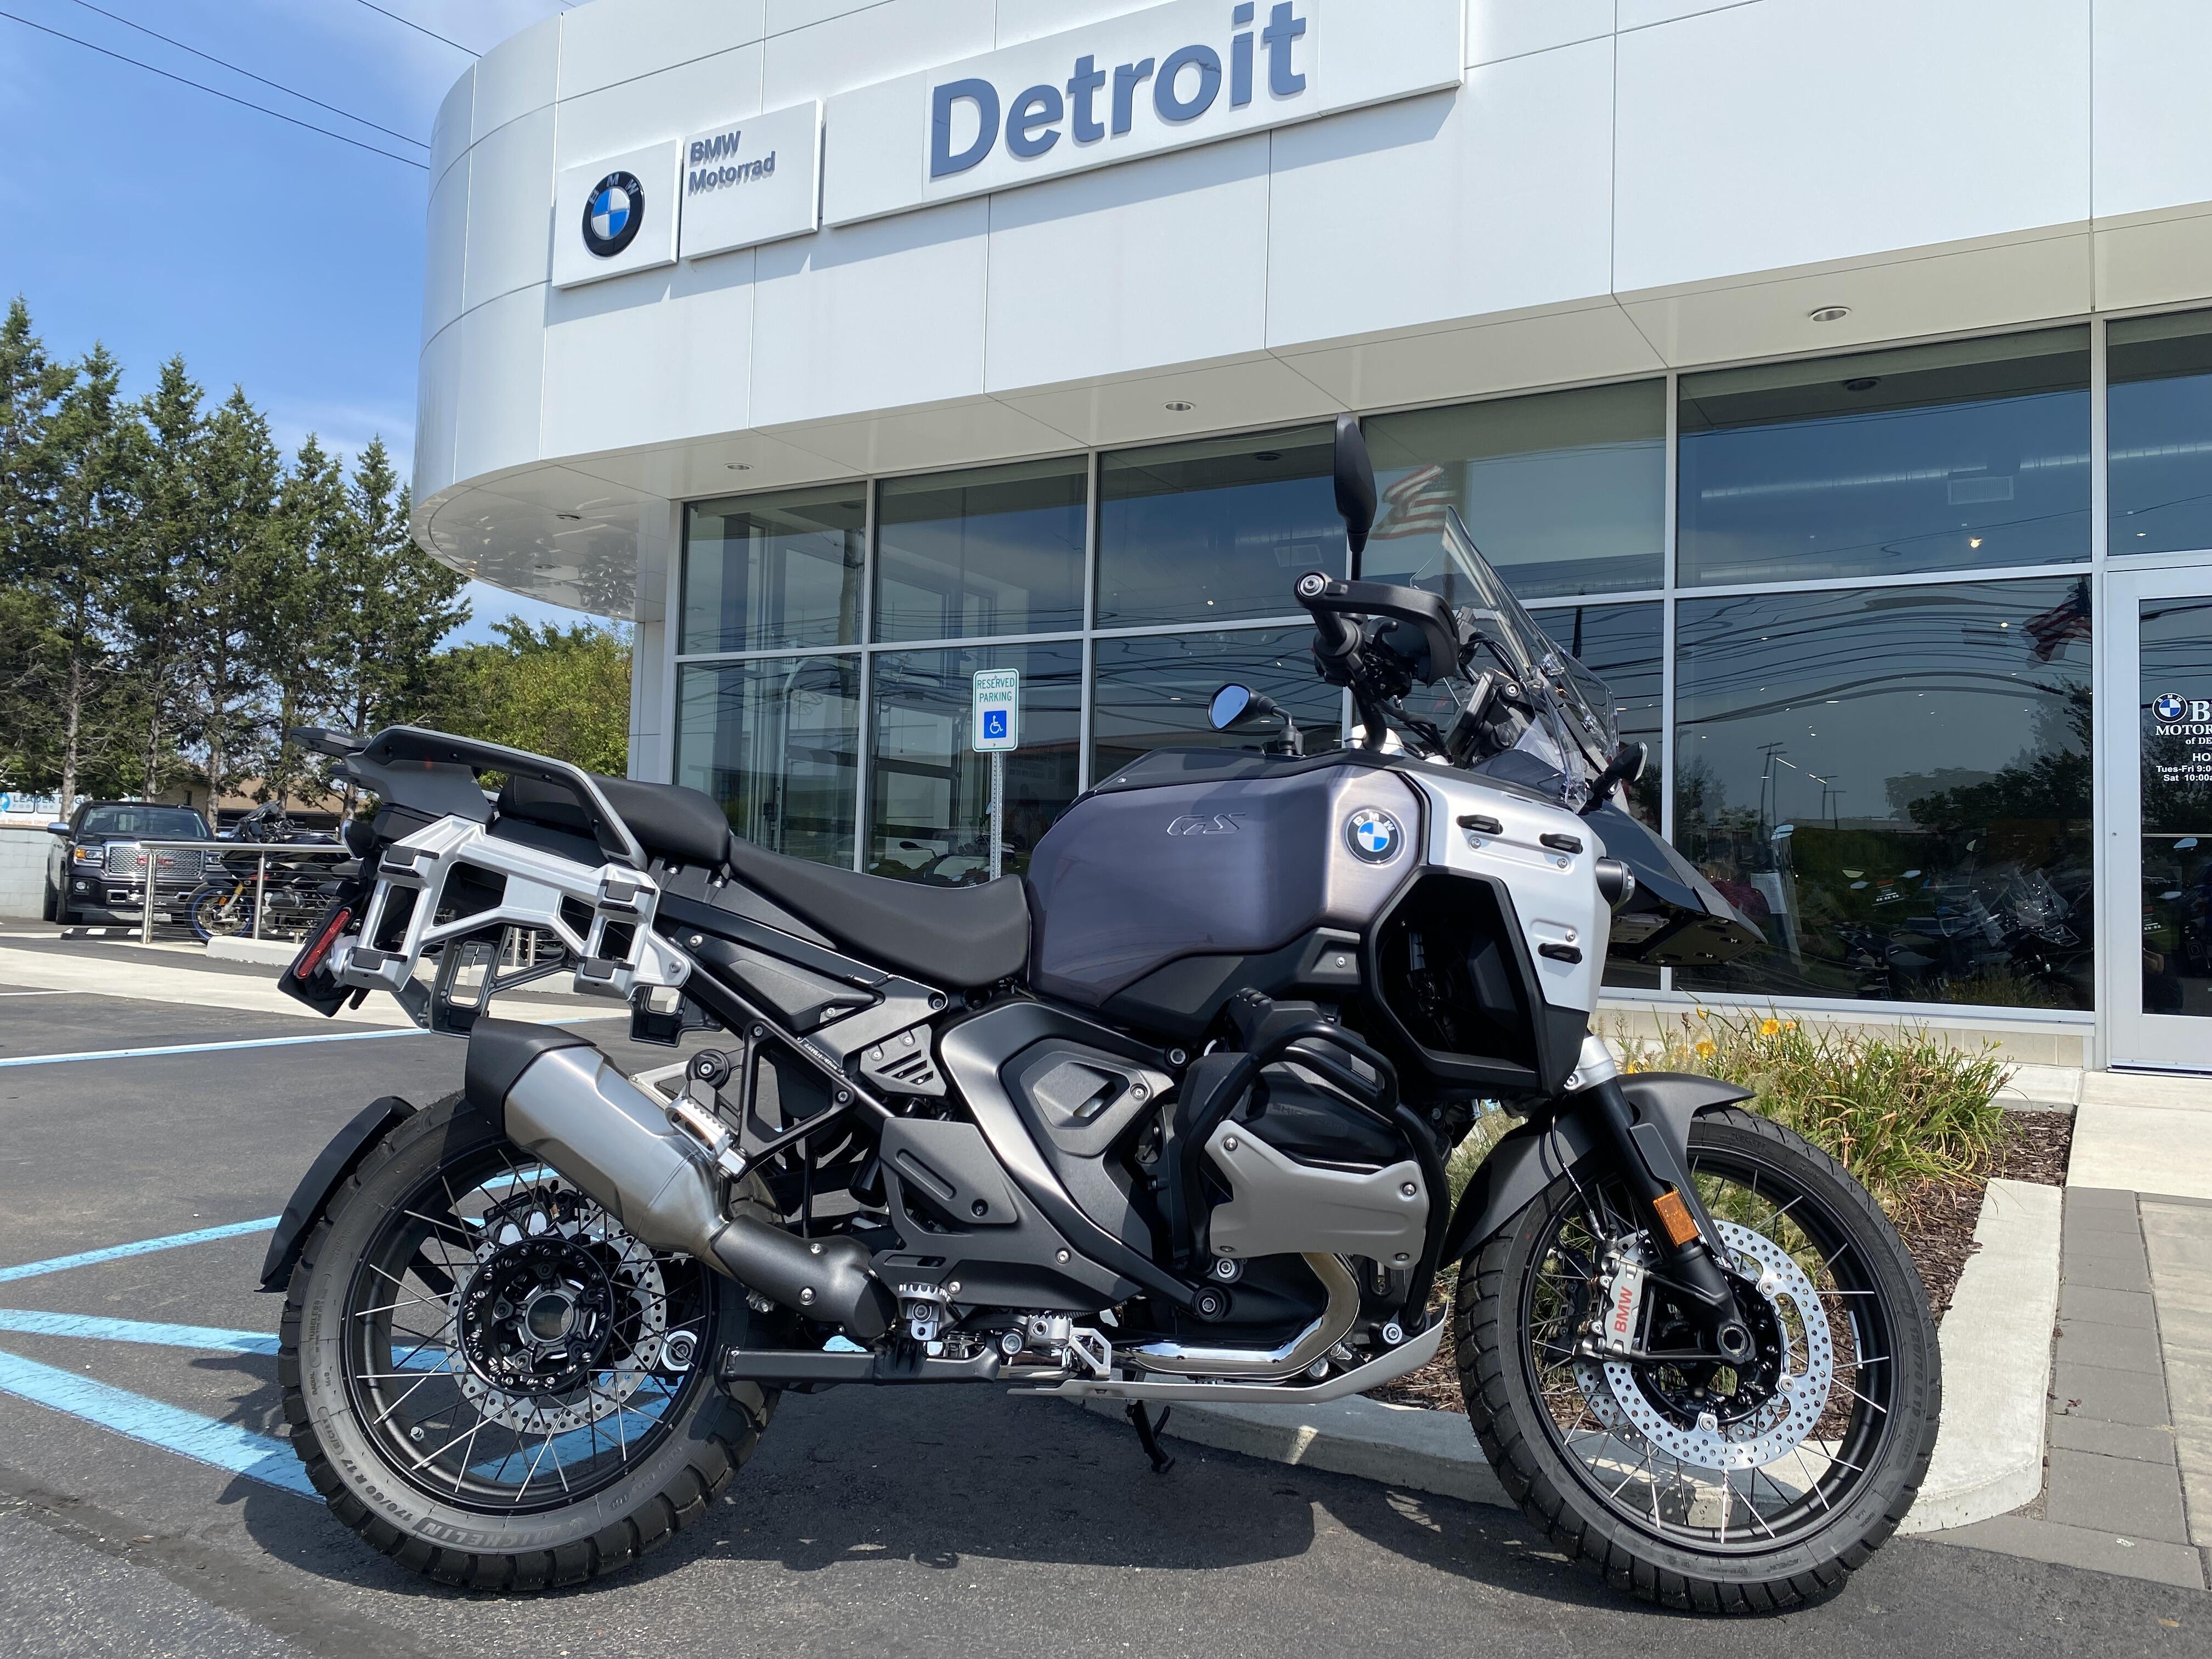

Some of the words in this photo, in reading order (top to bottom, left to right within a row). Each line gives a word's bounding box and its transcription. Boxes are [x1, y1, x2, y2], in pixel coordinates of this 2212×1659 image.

[932, 1, 1306, 178] Detroit
[690, 131, 741, 163] BMW
[689, 151, 776, 193] Motorrad
[977, 678, 1015, 690] RESERVED
[979, 691, 1012, 703] PARKING
[2190, 701, 2212, 721] B
[2192, 753, 2212, 761] HO
[1166, 812, 1246, 836] GS
[1614, 1286, 1633, 1333] BMW
[309, 1371, 318, 1396] RADIAL
[340, 1459, 358, 1473] 17
[354, 1474, 368, 1485] R
[421, 1522, 554, 1547] MICHELIN
